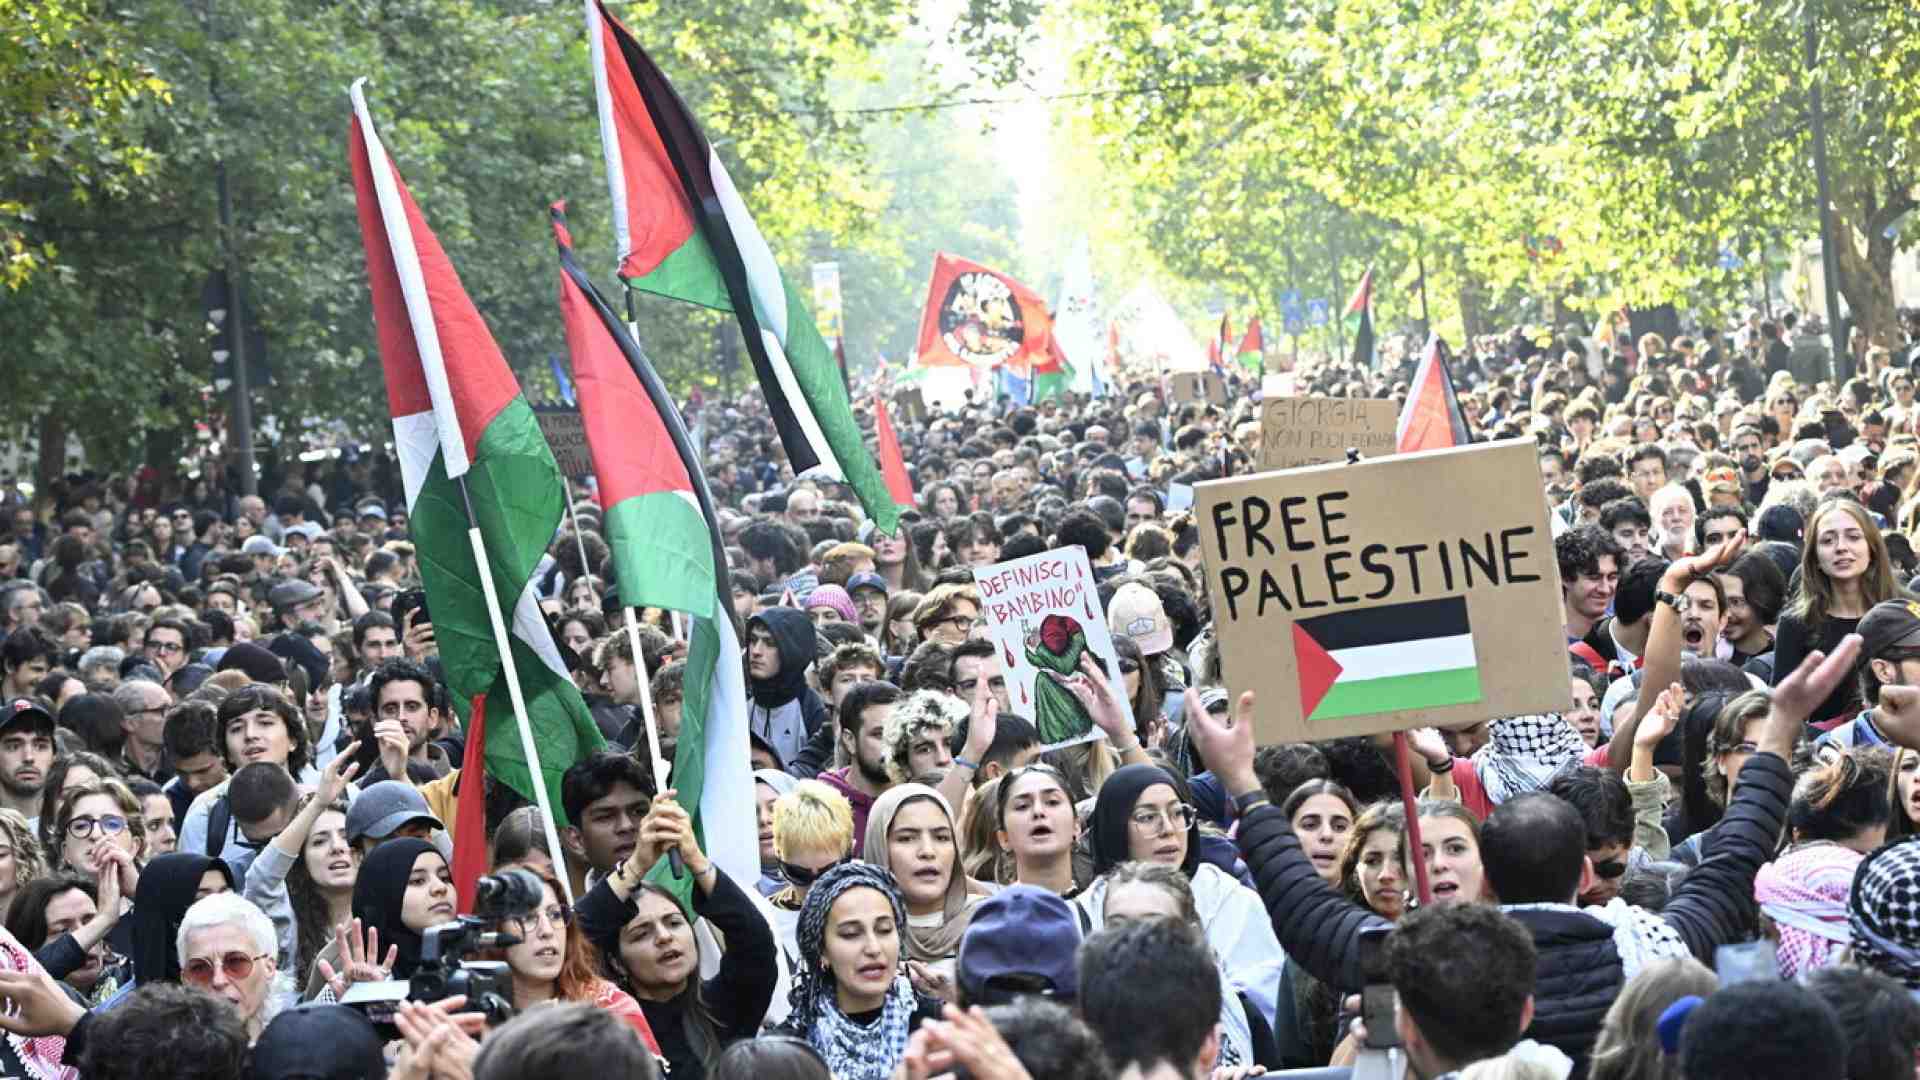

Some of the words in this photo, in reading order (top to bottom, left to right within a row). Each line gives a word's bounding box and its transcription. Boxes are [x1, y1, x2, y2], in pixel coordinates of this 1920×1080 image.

[1212, 490, 1350, 562] FREE
[978, 560, 1069, 598] DEFINISCI
[1220, 525, 1541, 621] PALESTINE
[983, 584, 1083, 625] "BAMBINO"
